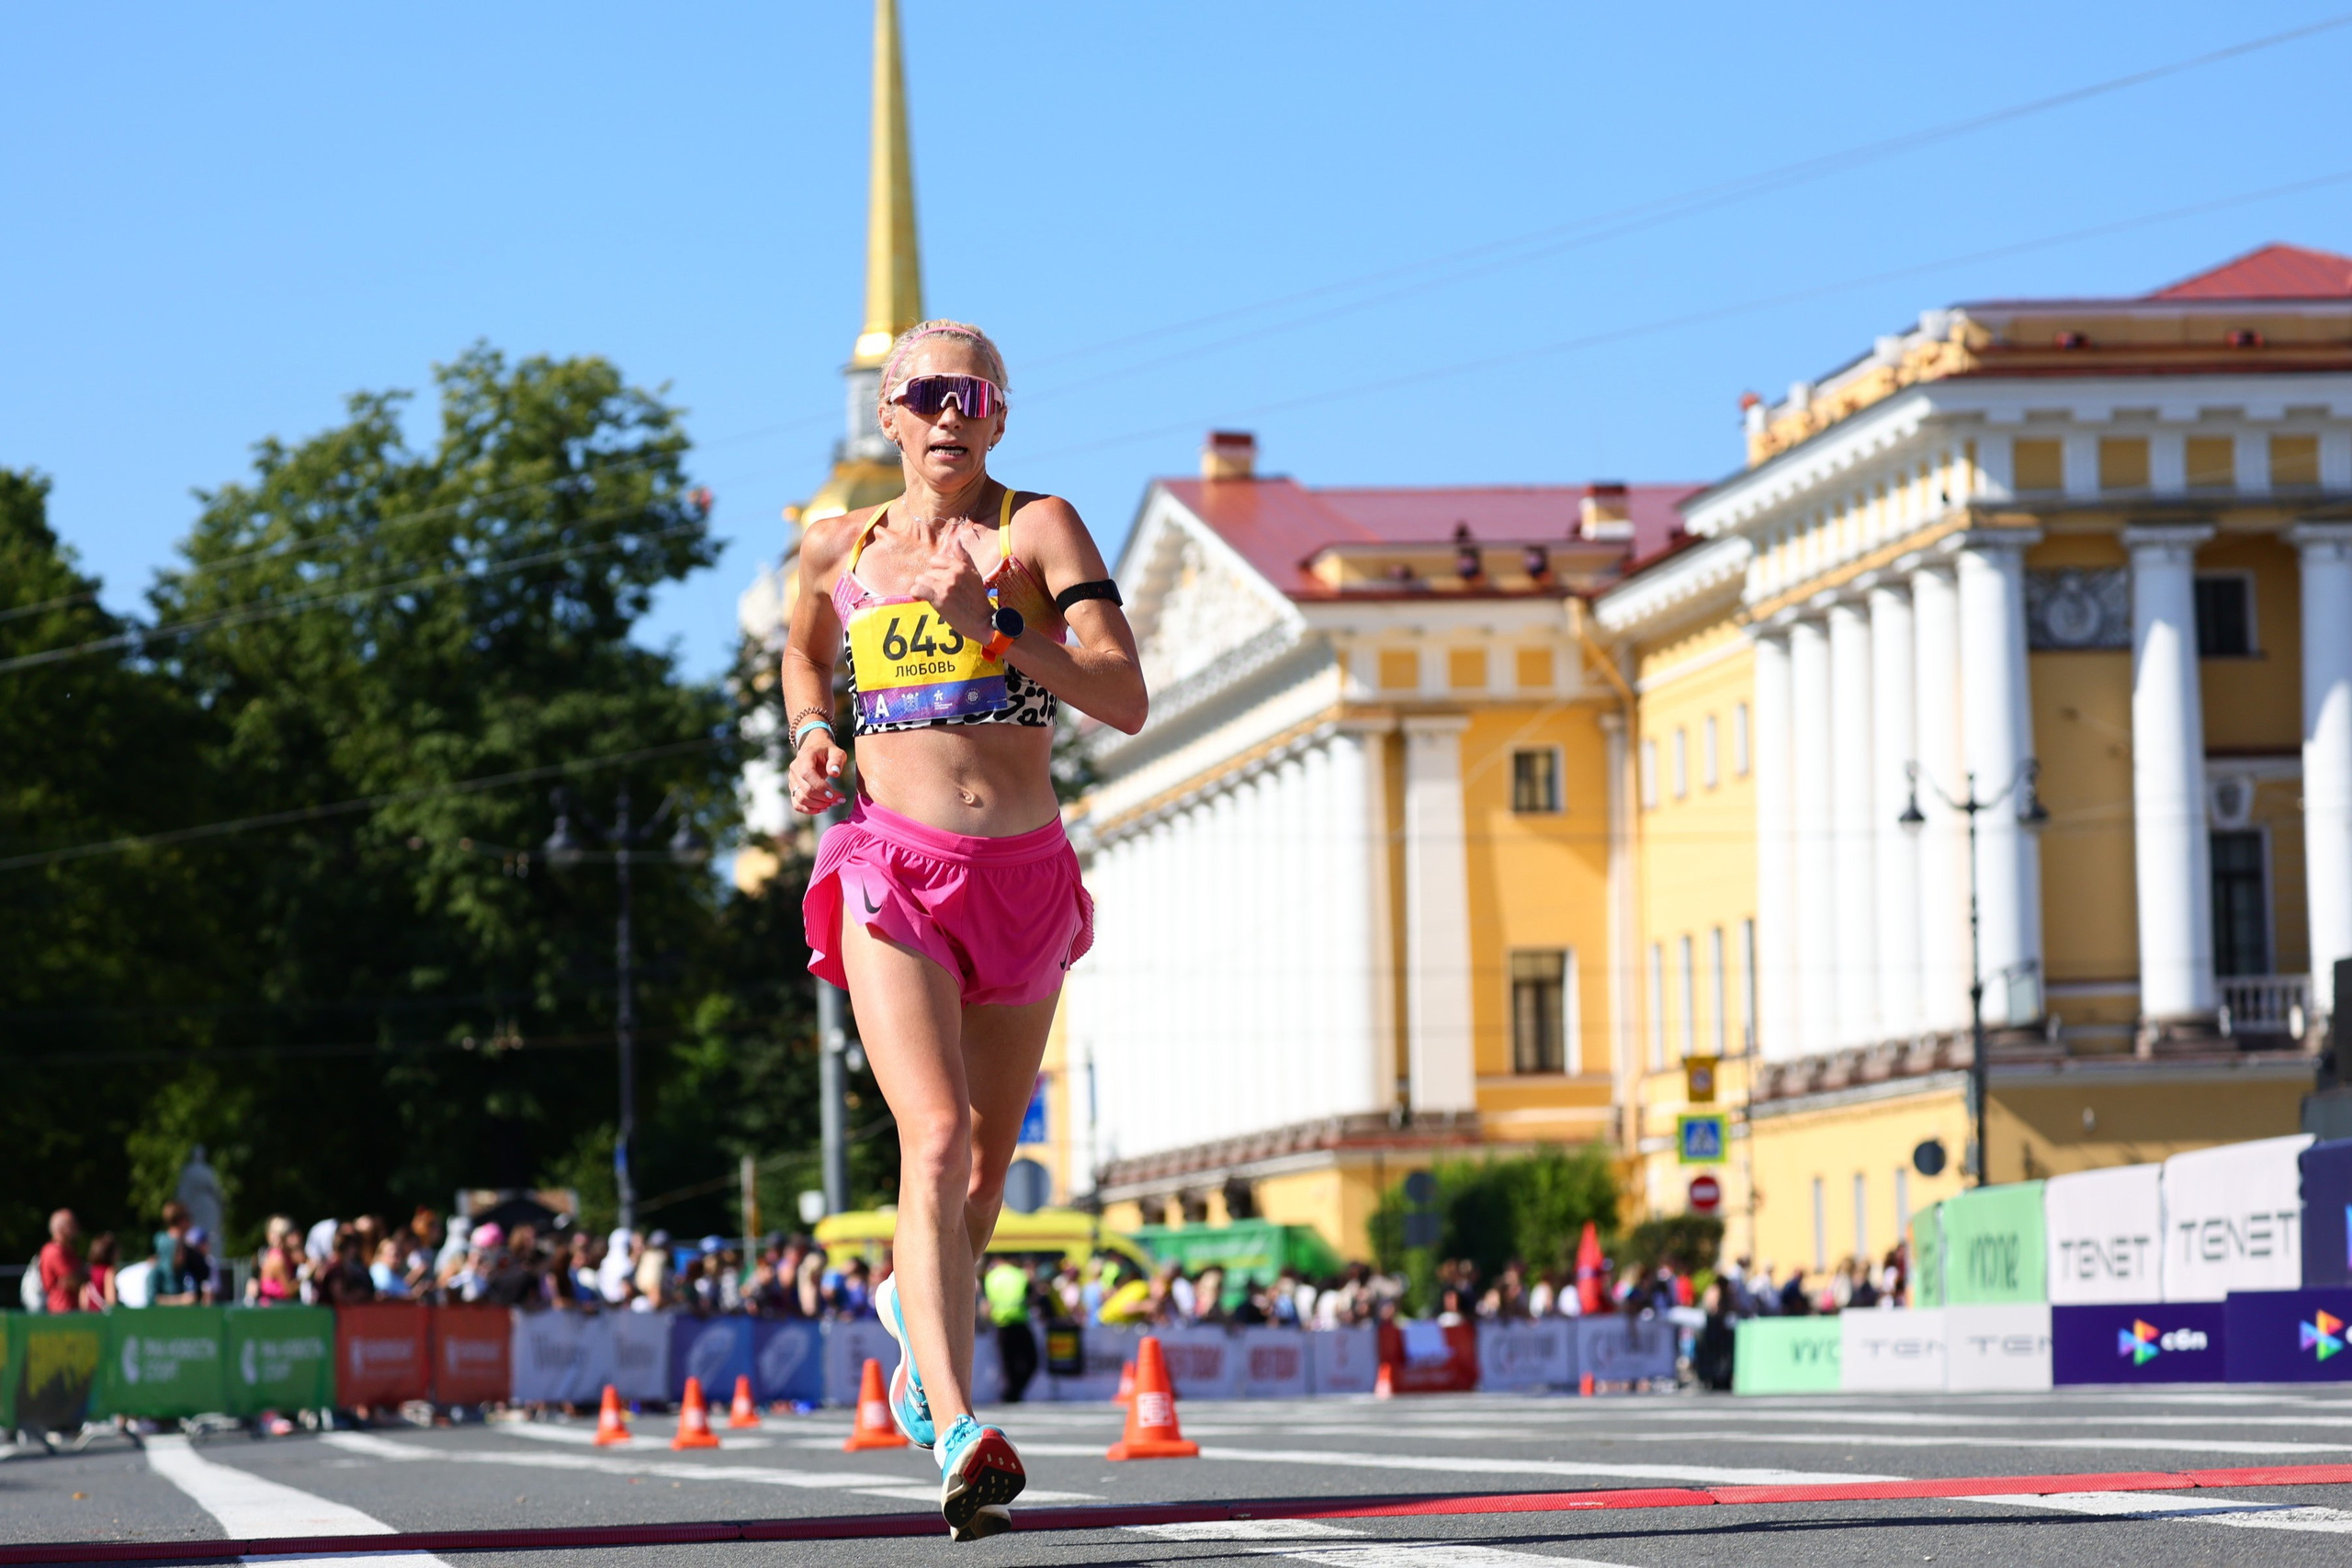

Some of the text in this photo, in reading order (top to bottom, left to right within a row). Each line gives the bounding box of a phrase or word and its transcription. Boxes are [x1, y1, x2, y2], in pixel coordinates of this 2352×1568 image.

[882, 615, 965, 661] 643
[895, 660, 956, 678] ЛЮБОВЬ
[2060, 1235, 2150, 1279] TENET
[2178, 1212, 2296, 1263] TENET
